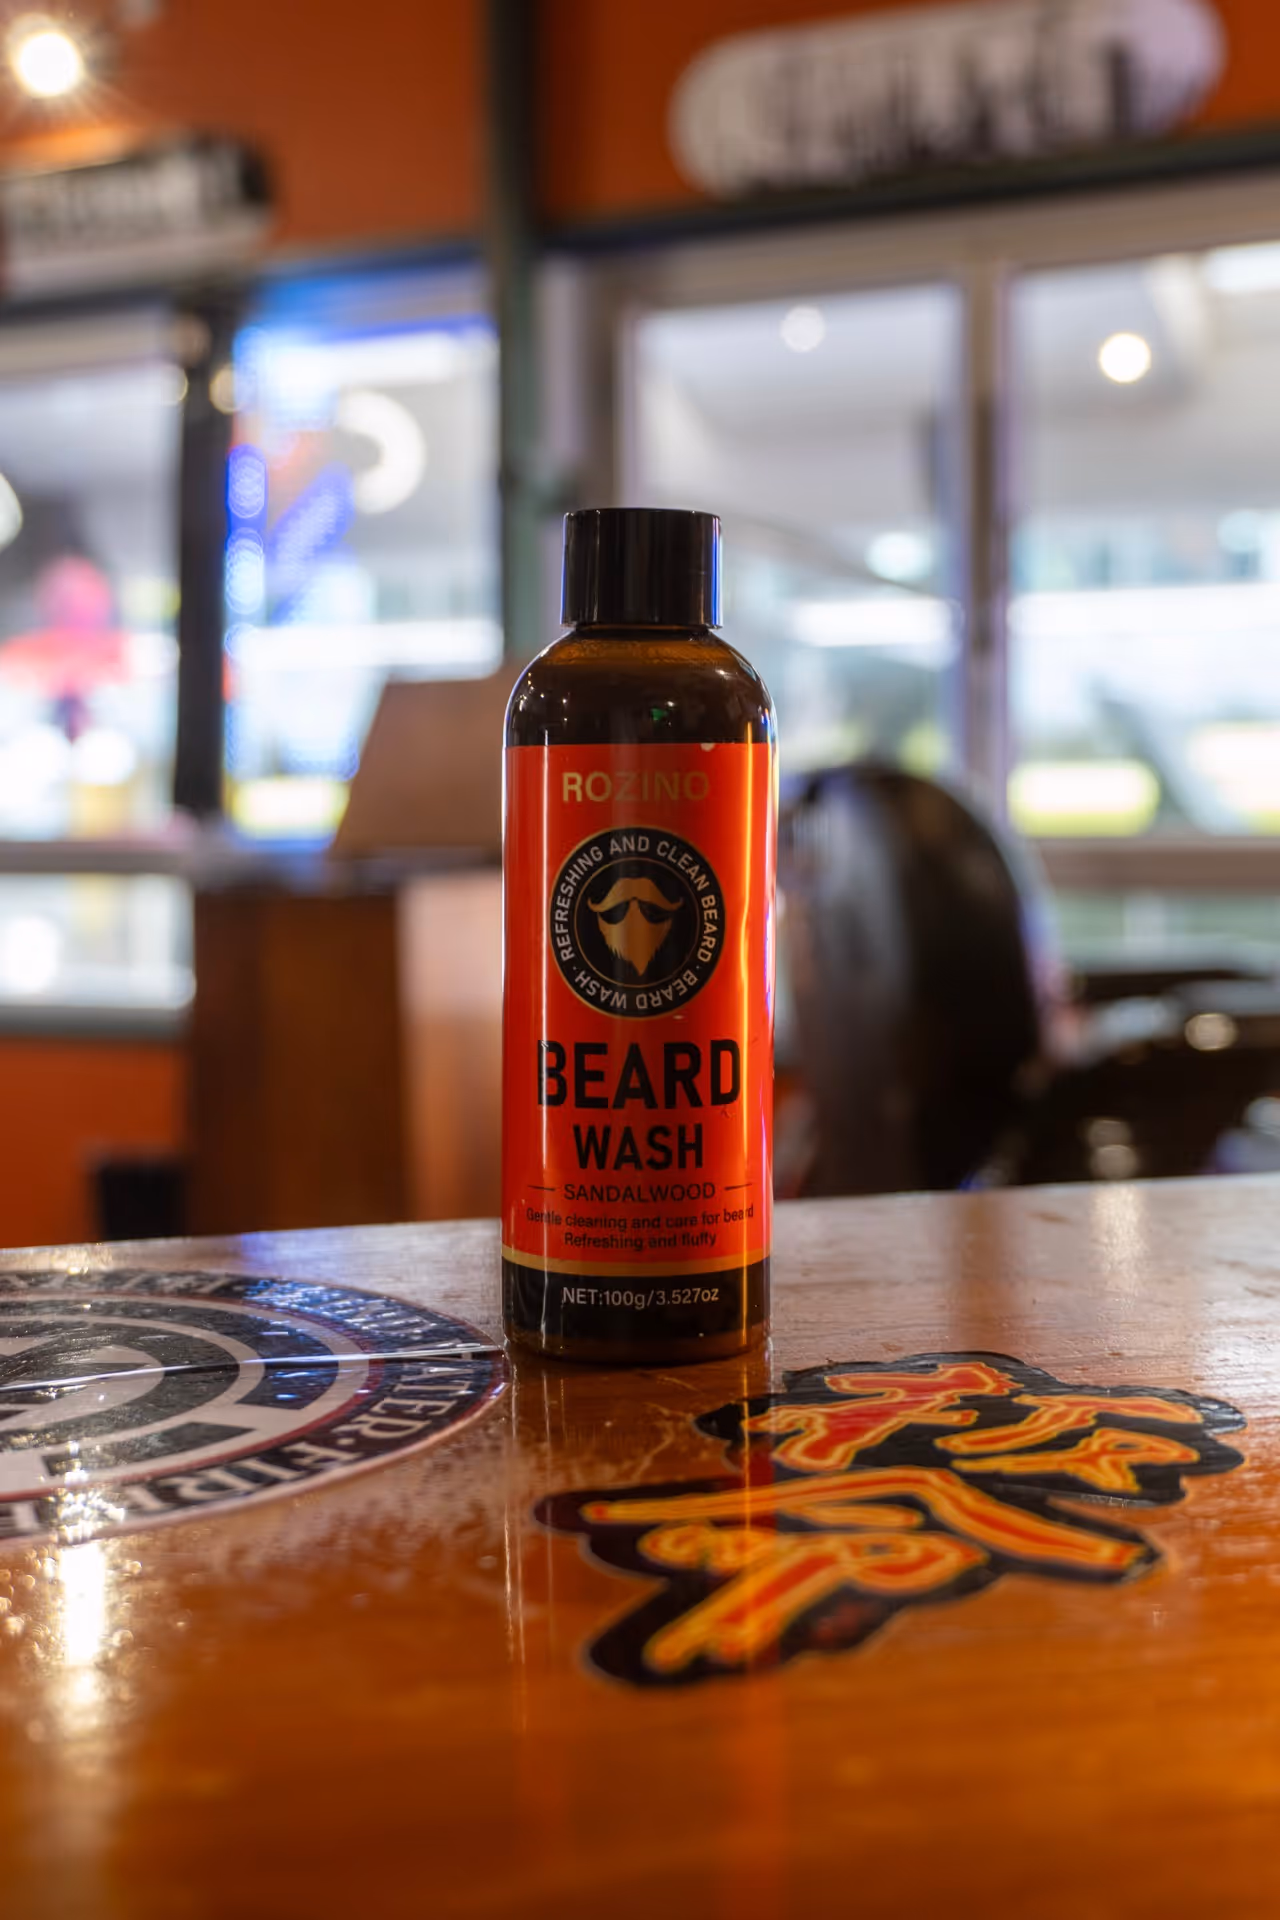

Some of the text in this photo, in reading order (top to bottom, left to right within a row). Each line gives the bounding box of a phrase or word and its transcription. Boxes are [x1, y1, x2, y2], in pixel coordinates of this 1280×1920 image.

[562, 772, 709, 802] ROZINO
[555, 835, 718, 962] REFRESHING AND CLEAN BEARD
[575, 969, 699, 1010] BEARD WASH
[537, 1039, 740, 1109] BEARD
[573, 1123, 703, 1171] WASH
[564, 1182, 716, 1203] SANDALWOOD
[526, 1203, 754, 1231] Gentle cleaning and care for beard
[564, 1231, 717, 1251] Refreshing and fluffy
